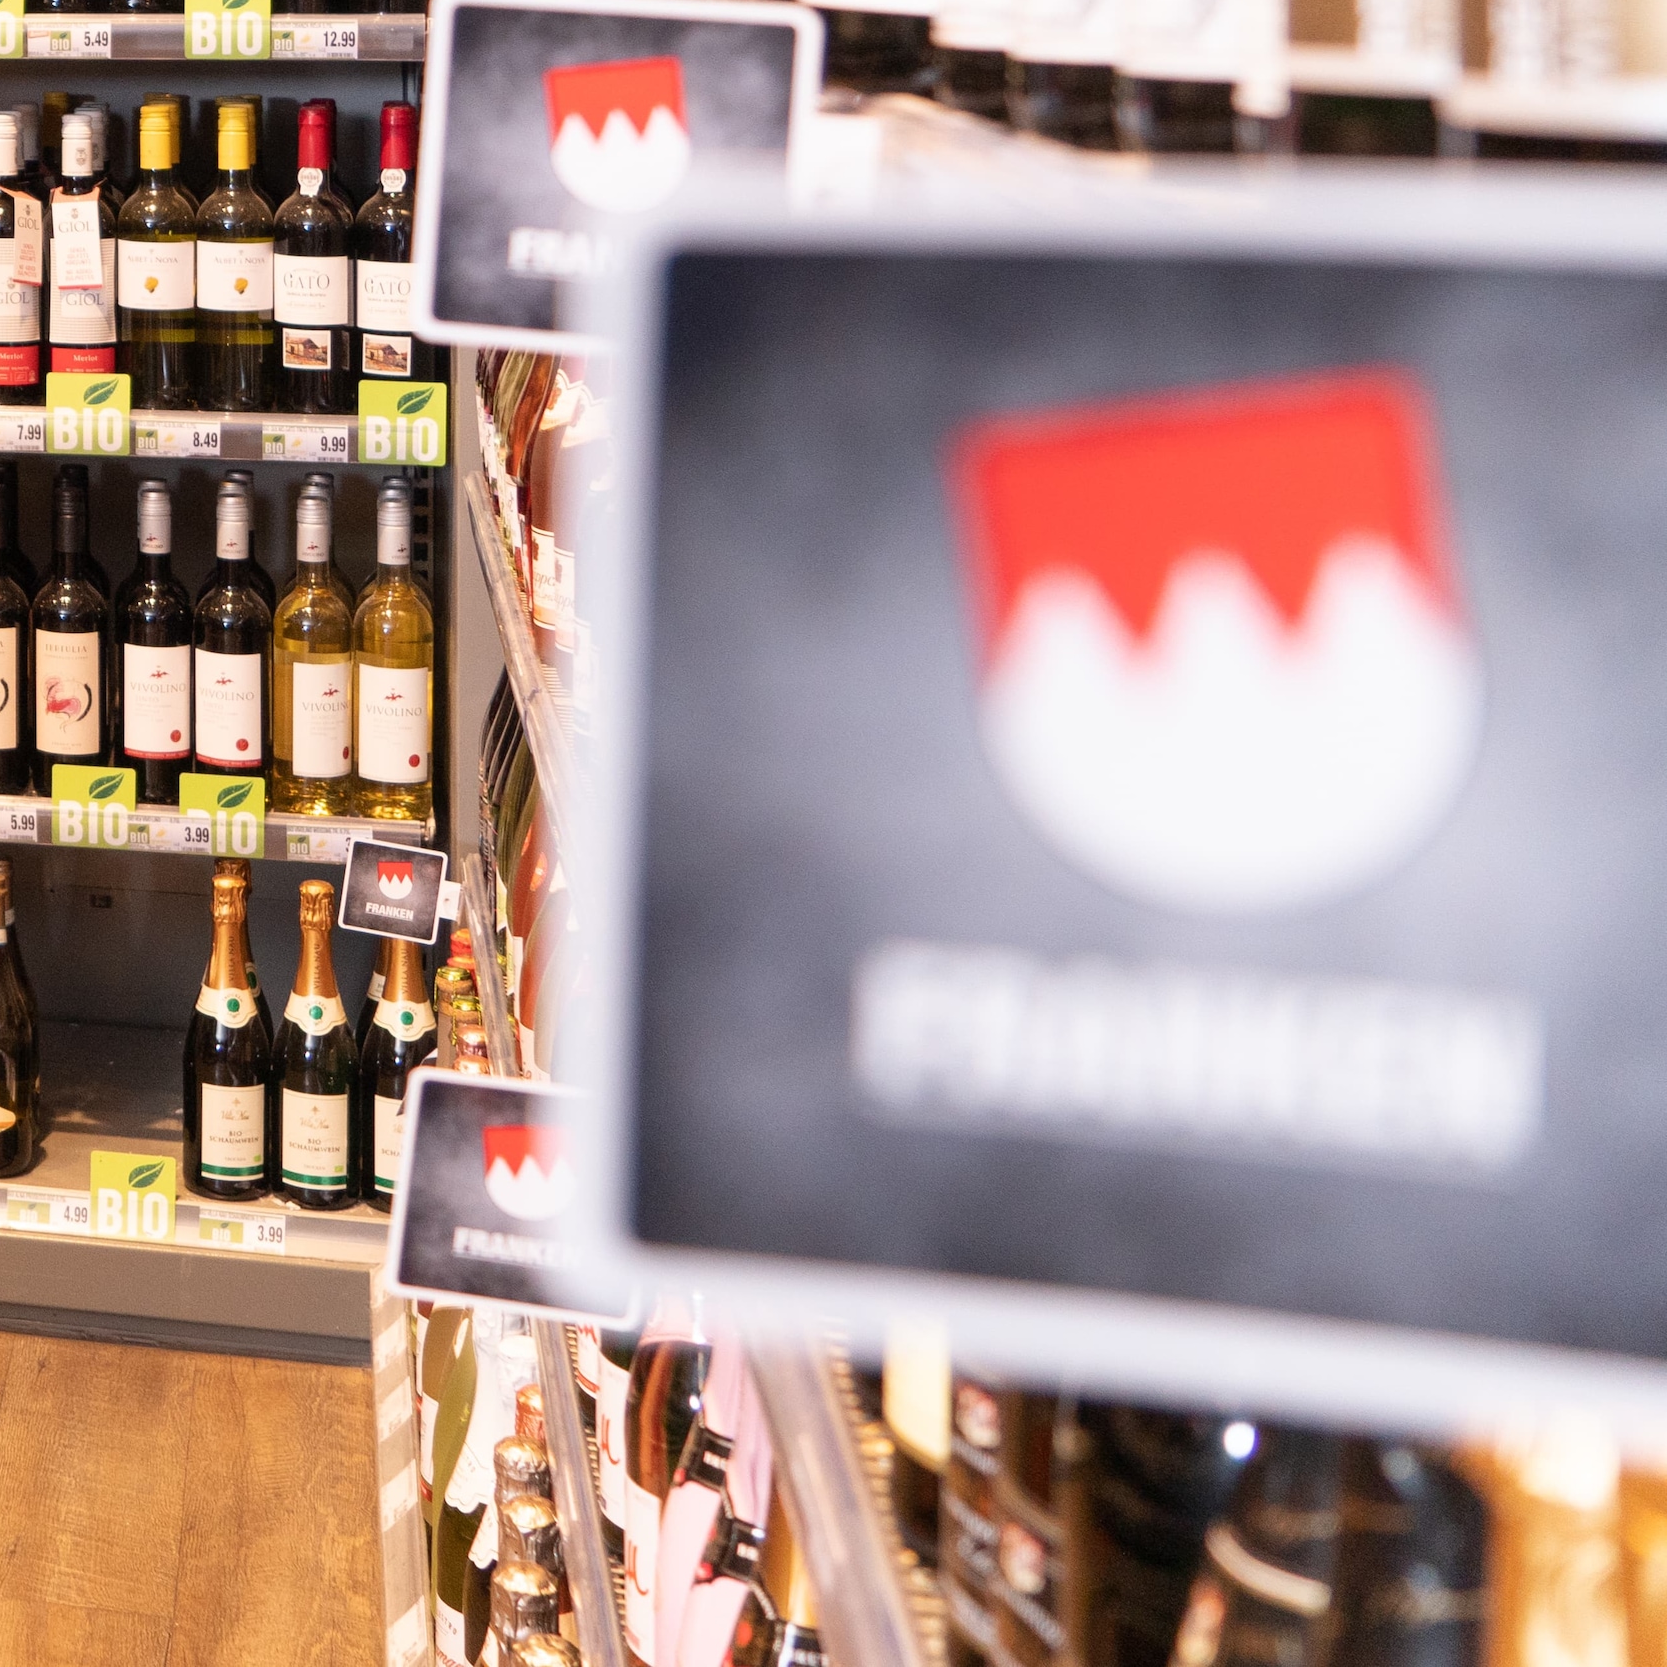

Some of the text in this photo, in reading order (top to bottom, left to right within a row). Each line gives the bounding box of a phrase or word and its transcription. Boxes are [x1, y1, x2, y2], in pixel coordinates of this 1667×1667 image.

[83, 31, 108, 47] 5.49
[192, 12, 263, 56] BIO
[323, 31, 356, 48] 12.99
[17, 217, 40, 230] GIOL
[58, 221, 94, 234] GIOL
[283, 272, 330, 291] GATO
[363, 277, 412, 296] GATO
[66, 292, 104, 306] GIOL
[0, 353, 24, 361] Merlot
[73, 354, 98, 362] Merlot
[17, 425, 41, 440] 7.99
[53, 408, 124, 452] BIO
[137, 436, 156, 450] BIO
[193, 432, 218, 449] 8.49
[320, 436, 346, 452] 9.99
[366, 418, 437, 463] BIO
[130, 681, 187, 694] VIVOLINO
[199, 687, 255, 702] VIVOLINO
[366, 705, 422, 717] VIVOLINO
[11, 815, 35, 831] 5.99
[58, 801, 129, 846] BIO
[185, 827, 210, 843] 3.99
[365, 902, 414, 921] FRANKEN
[209, 1136, 259, 1144] SCHAUMWEIN
[289, 1141, 340, 1153] SCHAUMWEIN
[63, 1206, 88, 1224] 4.99
[97, 1189, 170, 1240] BIO
[257, 1223, 283, 1243] 3.99
[453, 1228, 565, 1268] FRANKE
